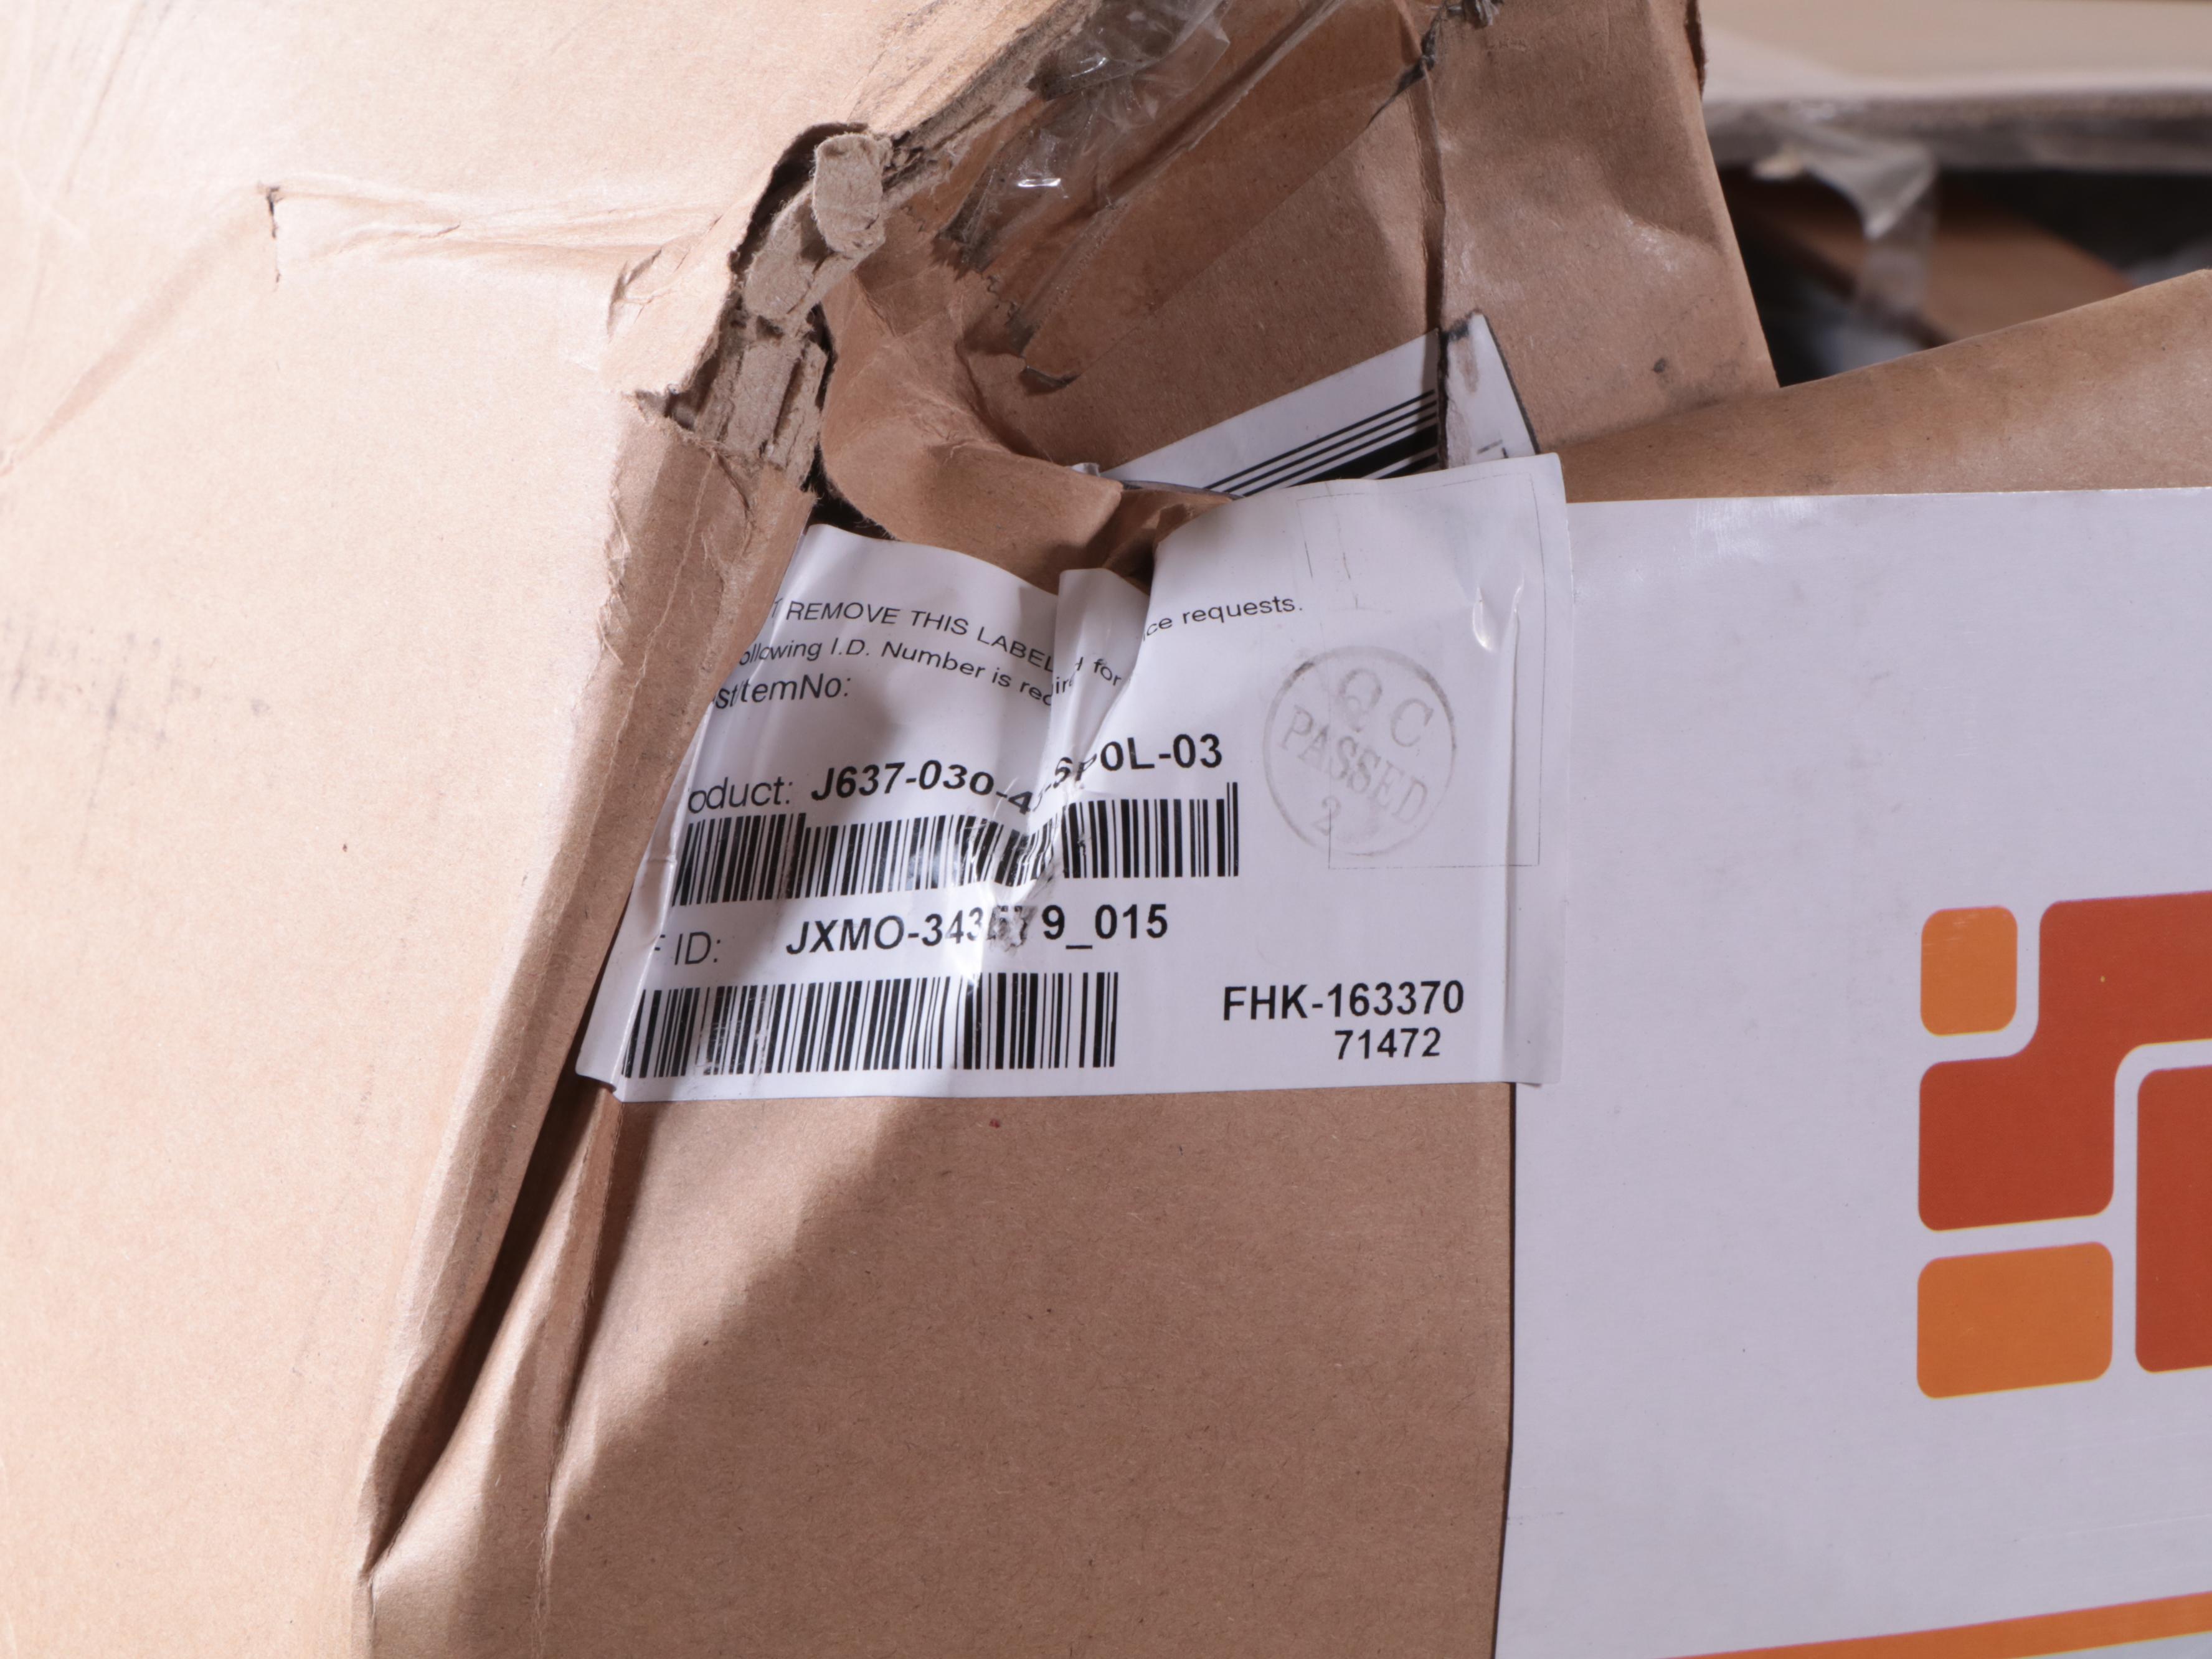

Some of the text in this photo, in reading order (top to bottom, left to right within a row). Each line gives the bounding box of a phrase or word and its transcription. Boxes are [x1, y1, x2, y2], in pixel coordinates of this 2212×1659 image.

[786, 601, 900, 625] REMOVE
[911, 610, 969, 635] THIS
[978, 626, 1054, 673] LABEL
[830, 638, 869, 656] I.D.
[881, 641, 986, 678] Number
[994, 667, 1012, 688] is
[1094, 658, 1122, 686] for
[1183, 595, 1303, 624] requests.
[1390, 698, 1435, 748] C
[1281, 705, 1429, 825] PASSED
[688, 777, 793, 814] oduct:
[674, 931, 721, 966] ID:
[1223, 980, 1464, 1021] FHK-163370
[1334, 1027, 1441, 1060] 71472
